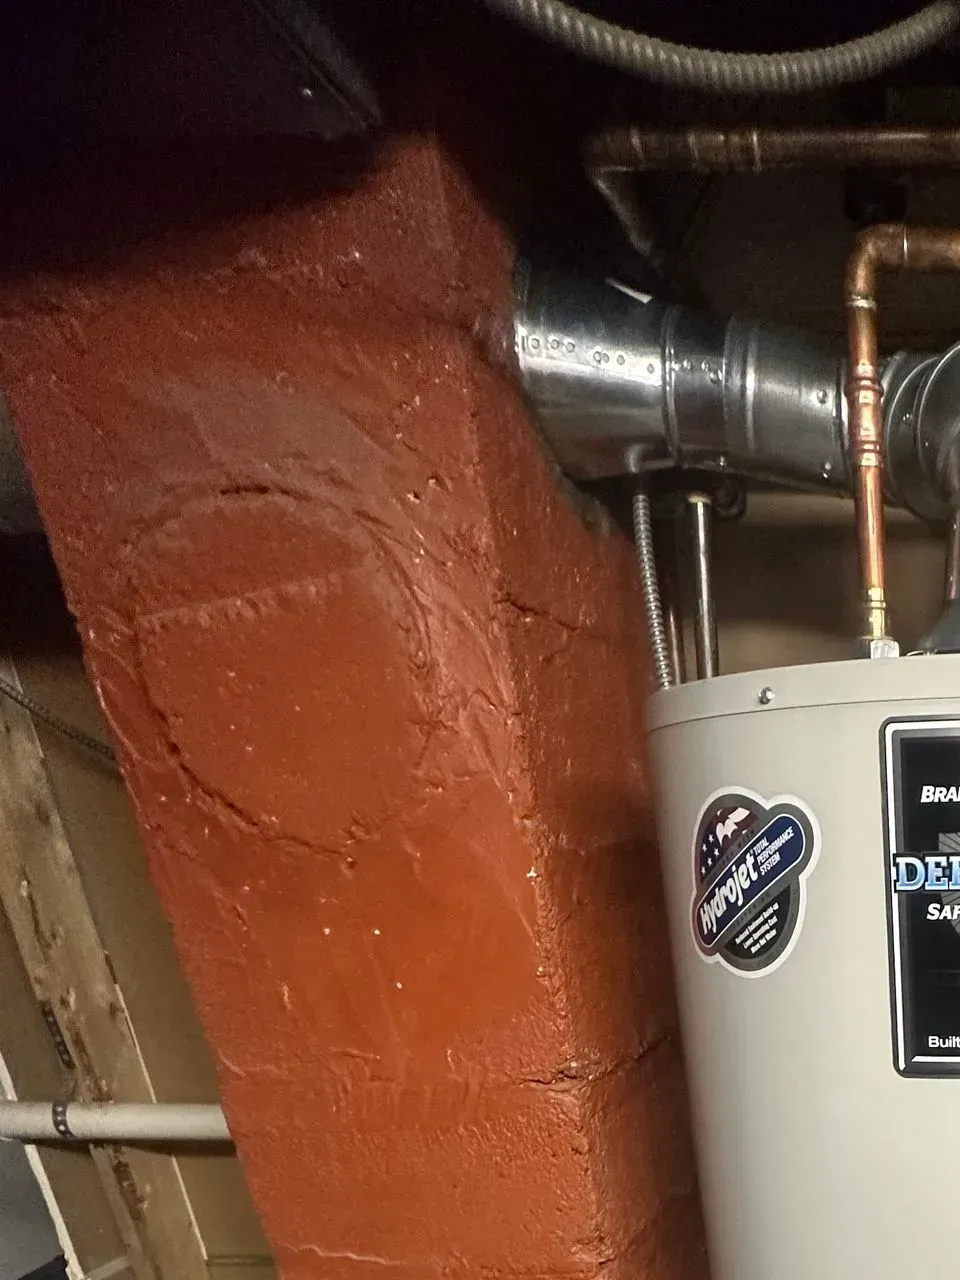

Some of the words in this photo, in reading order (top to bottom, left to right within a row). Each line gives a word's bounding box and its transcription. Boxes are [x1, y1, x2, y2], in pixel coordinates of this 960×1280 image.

[753, 837, 769, 855] TOTAL
[757, 826, 794, 865] PERFORMANCE
[760, 853, 780, 876] SYSTEM
[700, 850, 759, 935] Hydrojet
